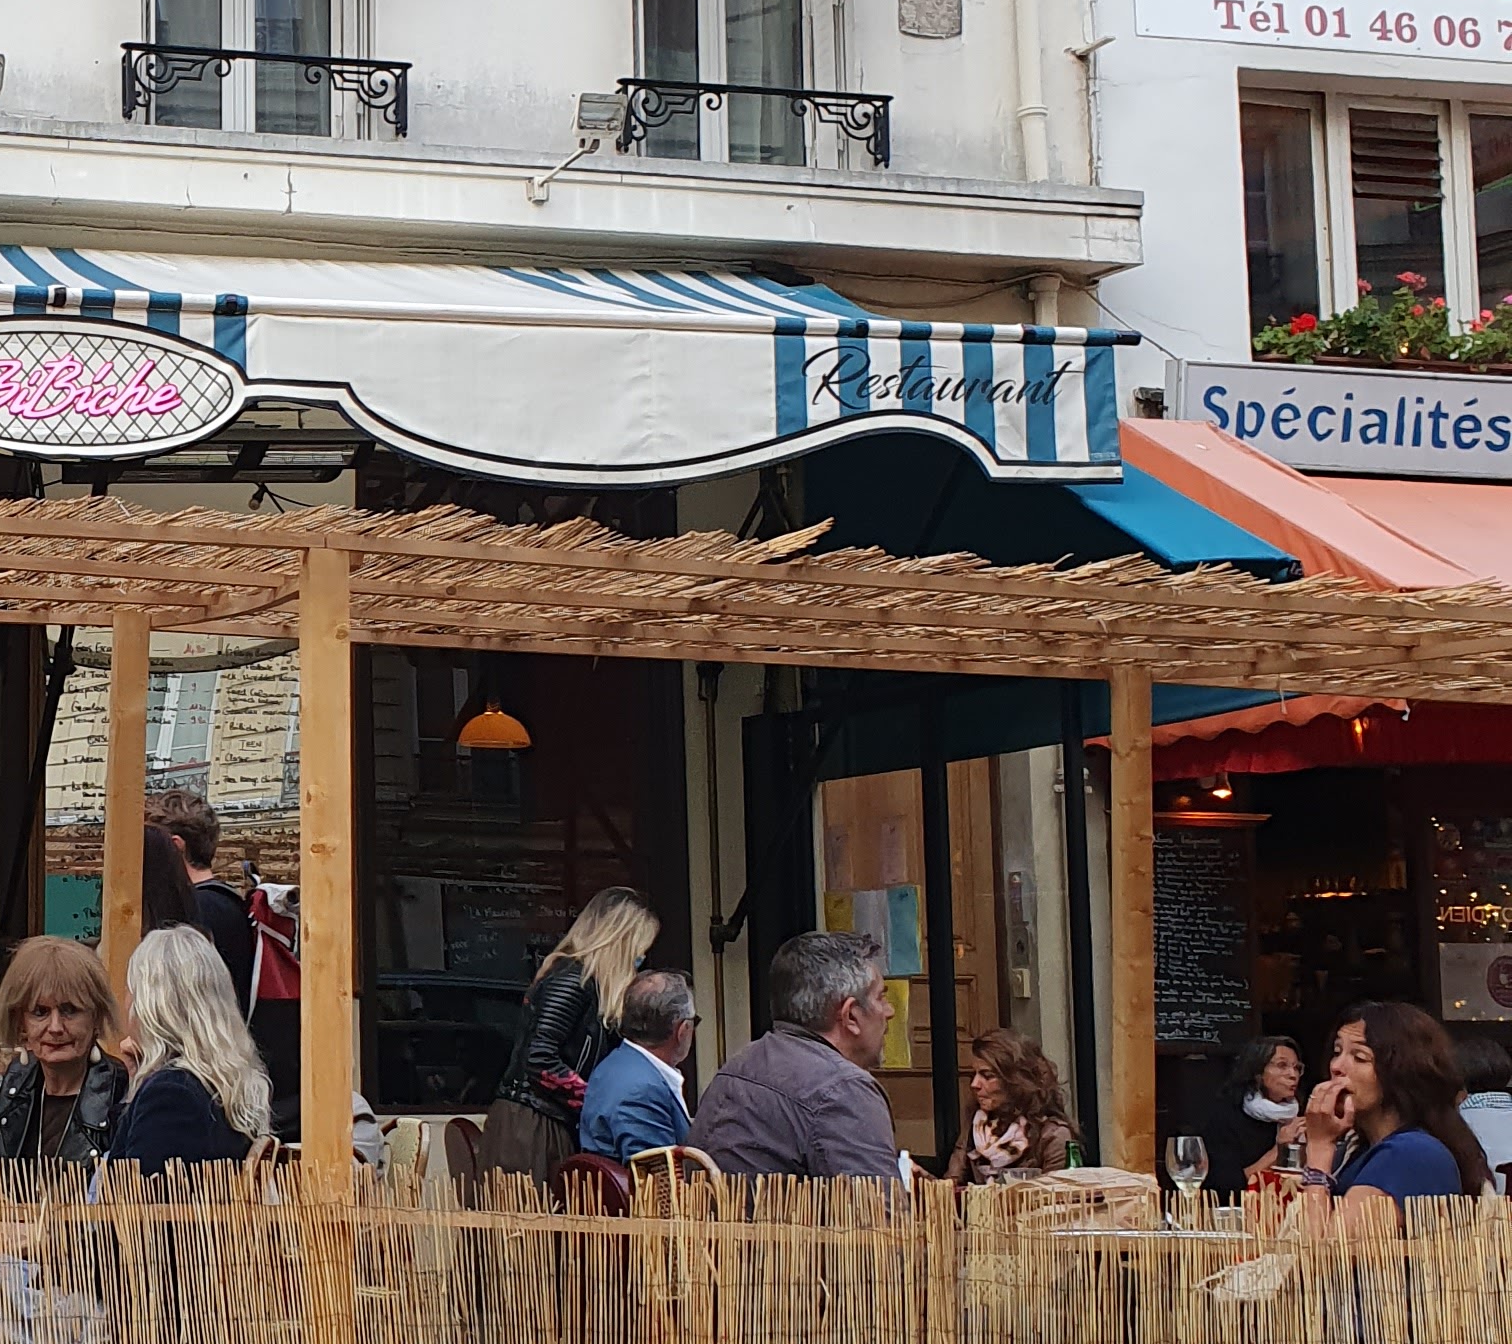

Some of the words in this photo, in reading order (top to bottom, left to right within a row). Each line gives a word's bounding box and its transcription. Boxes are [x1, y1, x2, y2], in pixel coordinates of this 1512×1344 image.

[1304, 5, 1351, 38] 01
[1369, 9, 1418, 44] 46
[1433, 14, 1481, 49] 06
[801, 345, 1090, 410] Restaurant
[1202, 385, 1511, 452] Spécialités
